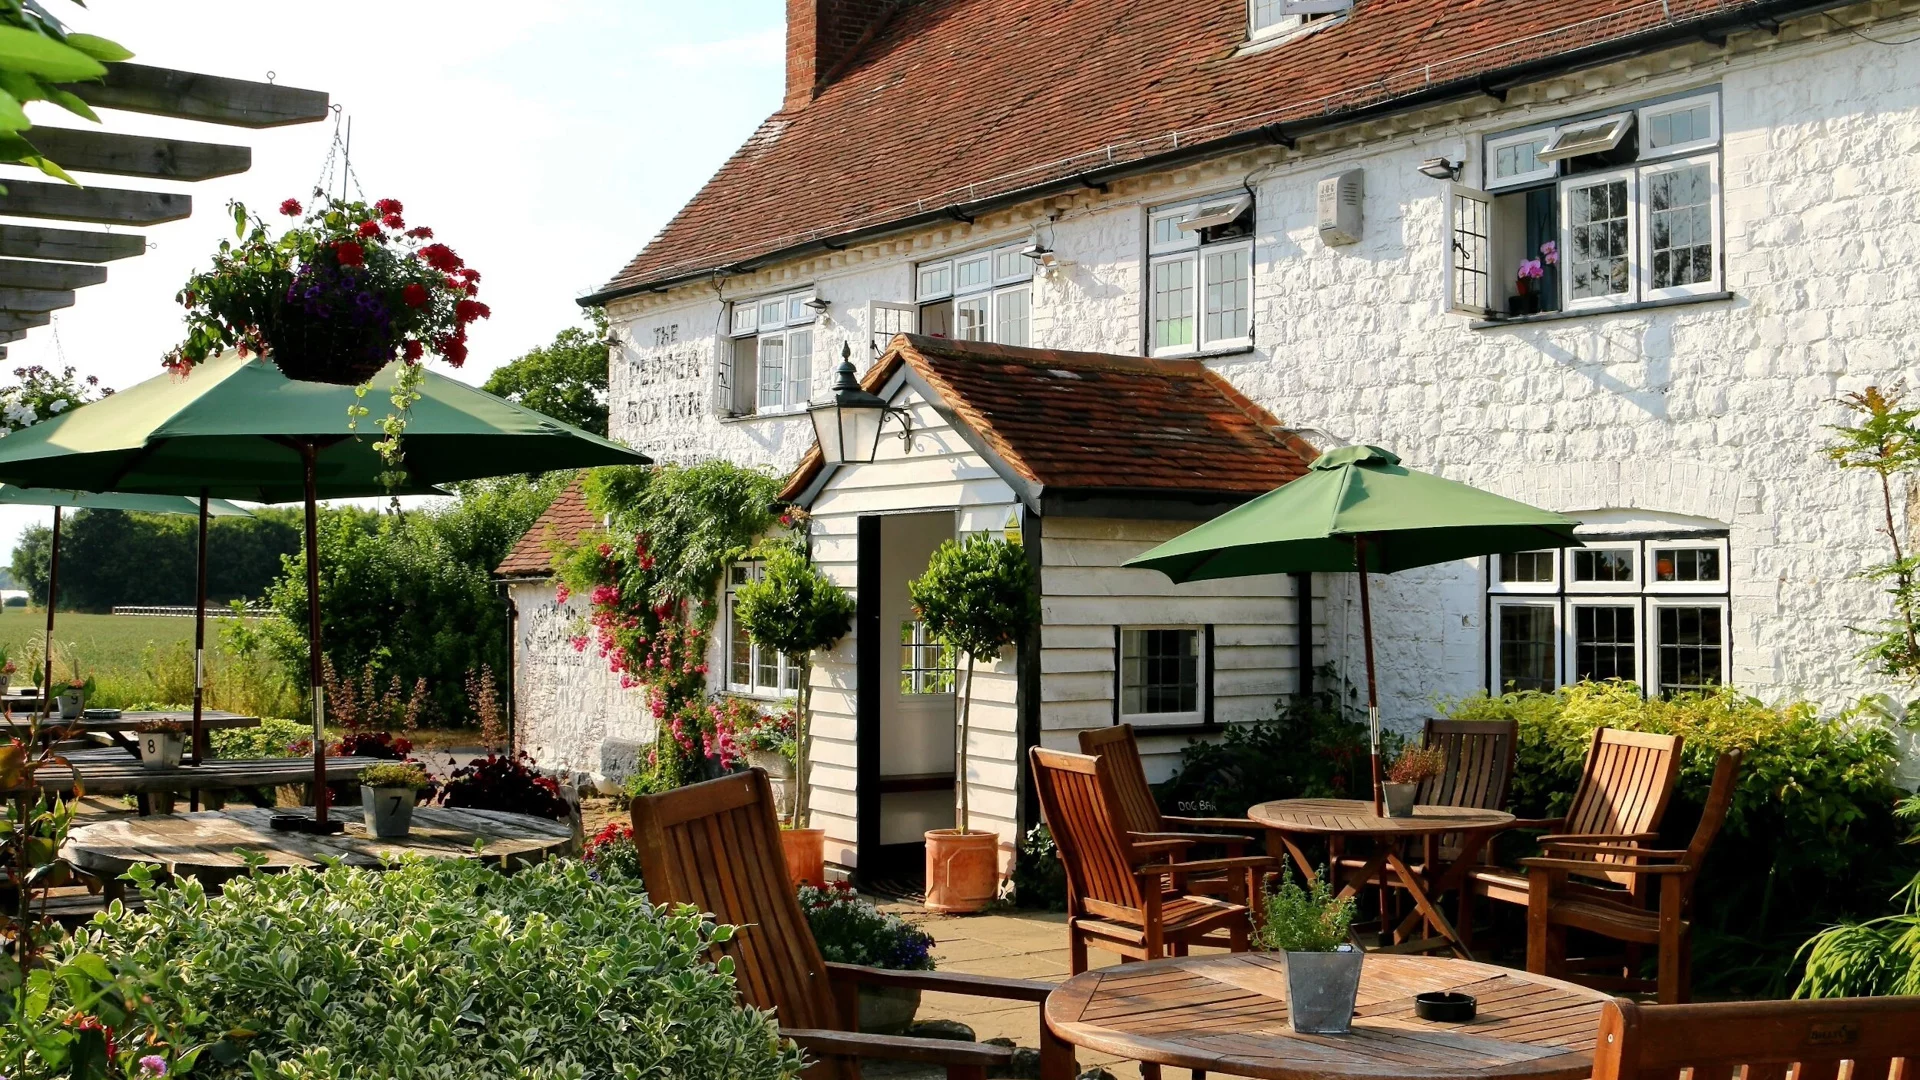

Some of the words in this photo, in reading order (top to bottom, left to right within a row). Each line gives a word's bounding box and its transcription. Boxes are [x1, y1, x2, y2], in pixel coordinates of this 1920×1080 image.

[653, 323, 678, 346] THE
[629, 350, 700, 387] PEPPER
[668, 391, 702, 420] INN
[147, 738, 156, 755] 8
[390, 796, 402, 816] 7
[1178, 800, 1198, 812] DOG
